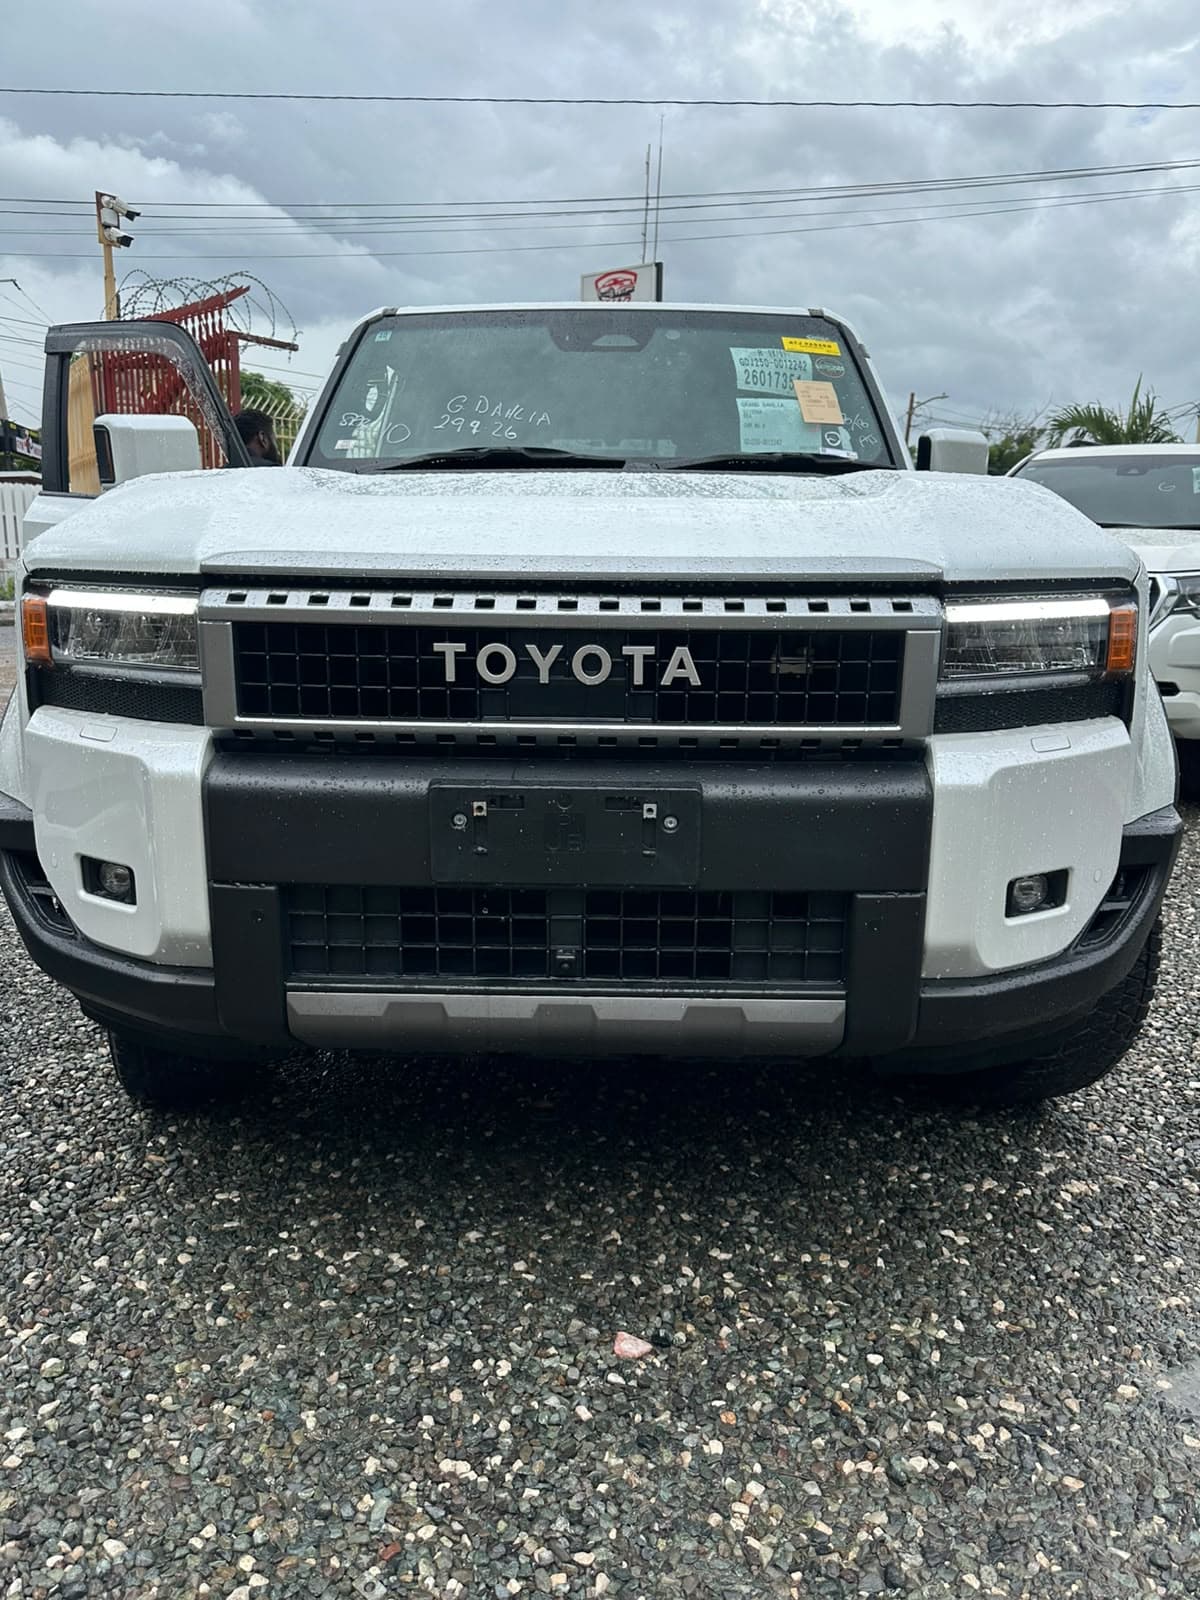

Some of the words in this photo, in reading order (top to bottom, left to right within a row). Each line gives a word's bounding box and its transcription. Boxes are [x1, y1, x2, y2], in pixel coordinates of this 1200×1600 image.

[447, 395, 467, 413] G
[492, 421, 517, 439] 26
[433, 643, 702, 686] TOYOTA
